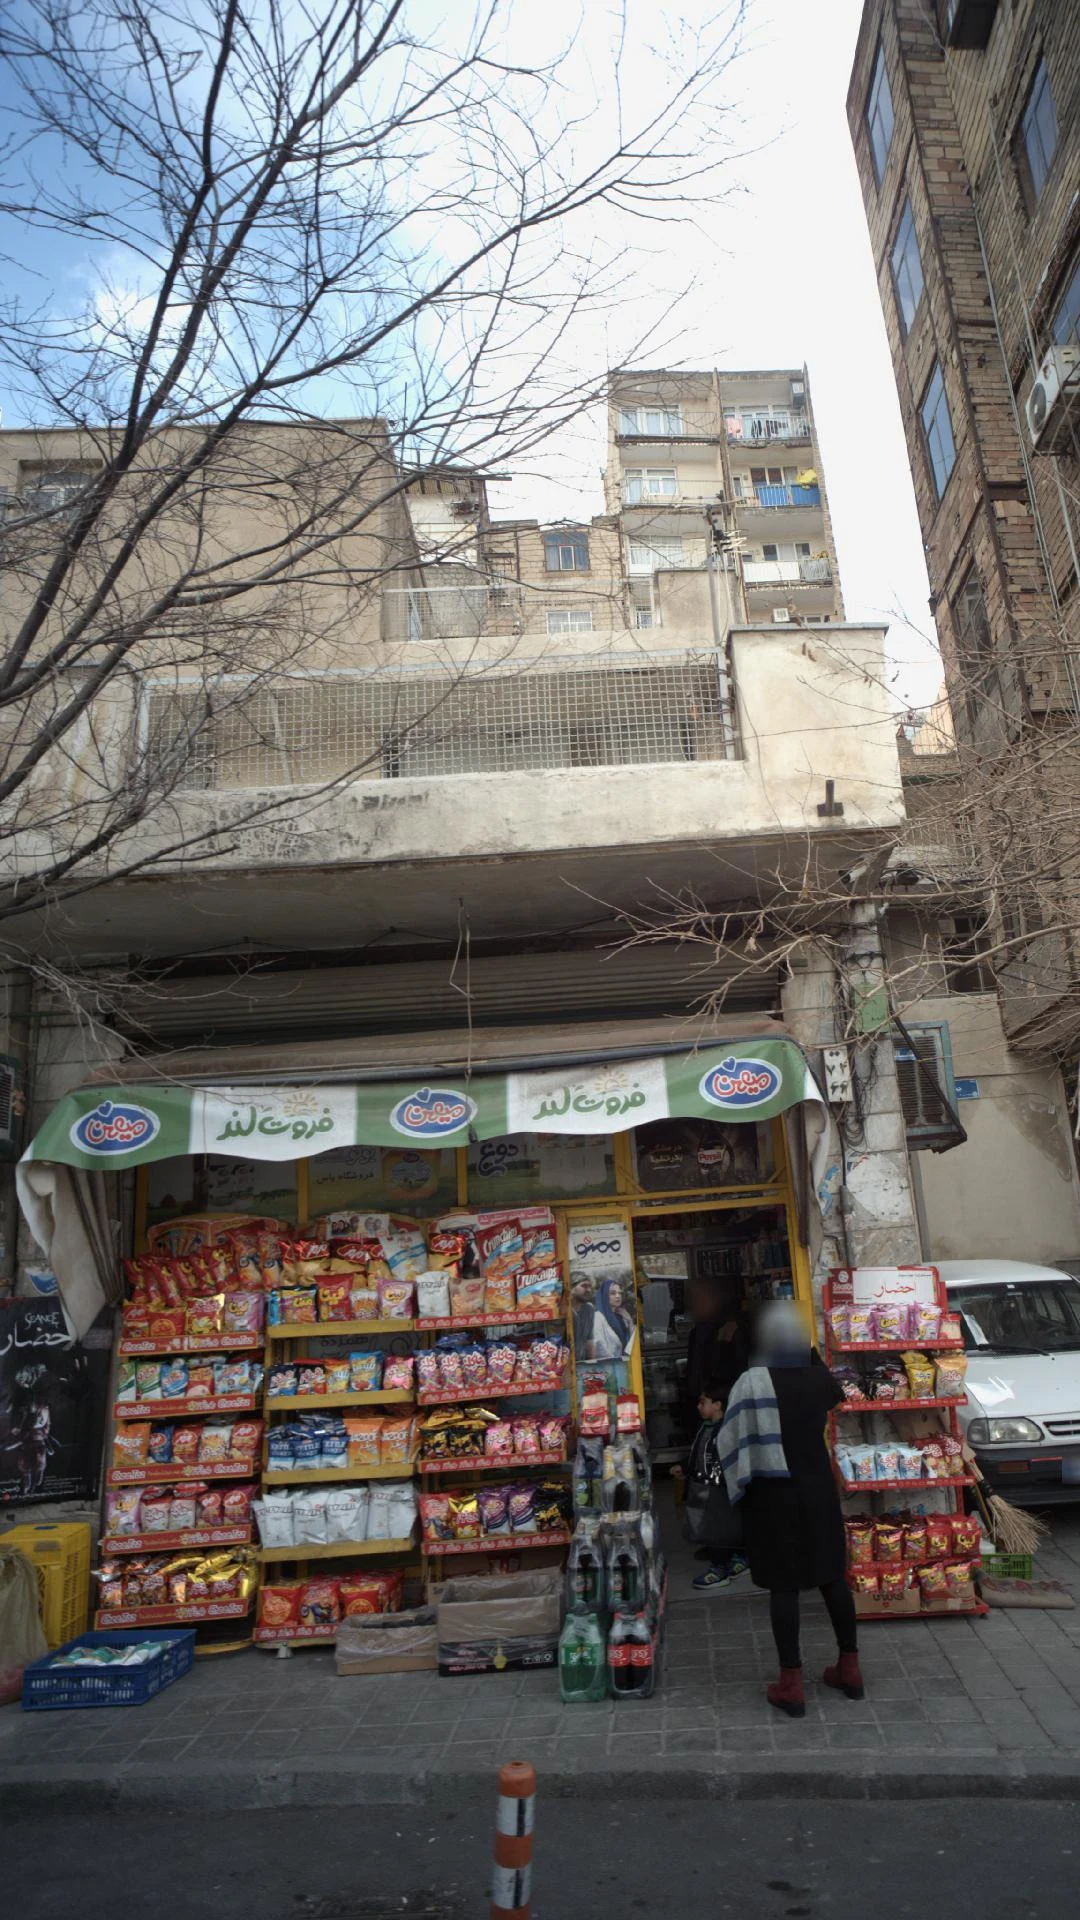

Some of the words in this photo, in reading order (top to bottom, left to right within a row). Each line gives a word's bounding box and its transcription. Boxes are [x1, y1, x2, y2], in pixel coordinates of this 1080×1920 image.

[711, 1071, 773, 1098] میهن
[403, 1102, 467, 1127] میهن
[85, 1115, 149, 1144] میهن
[516, 1268, 558, 1288] Crunchips
[0, 1321, 72, 1356] حضار
